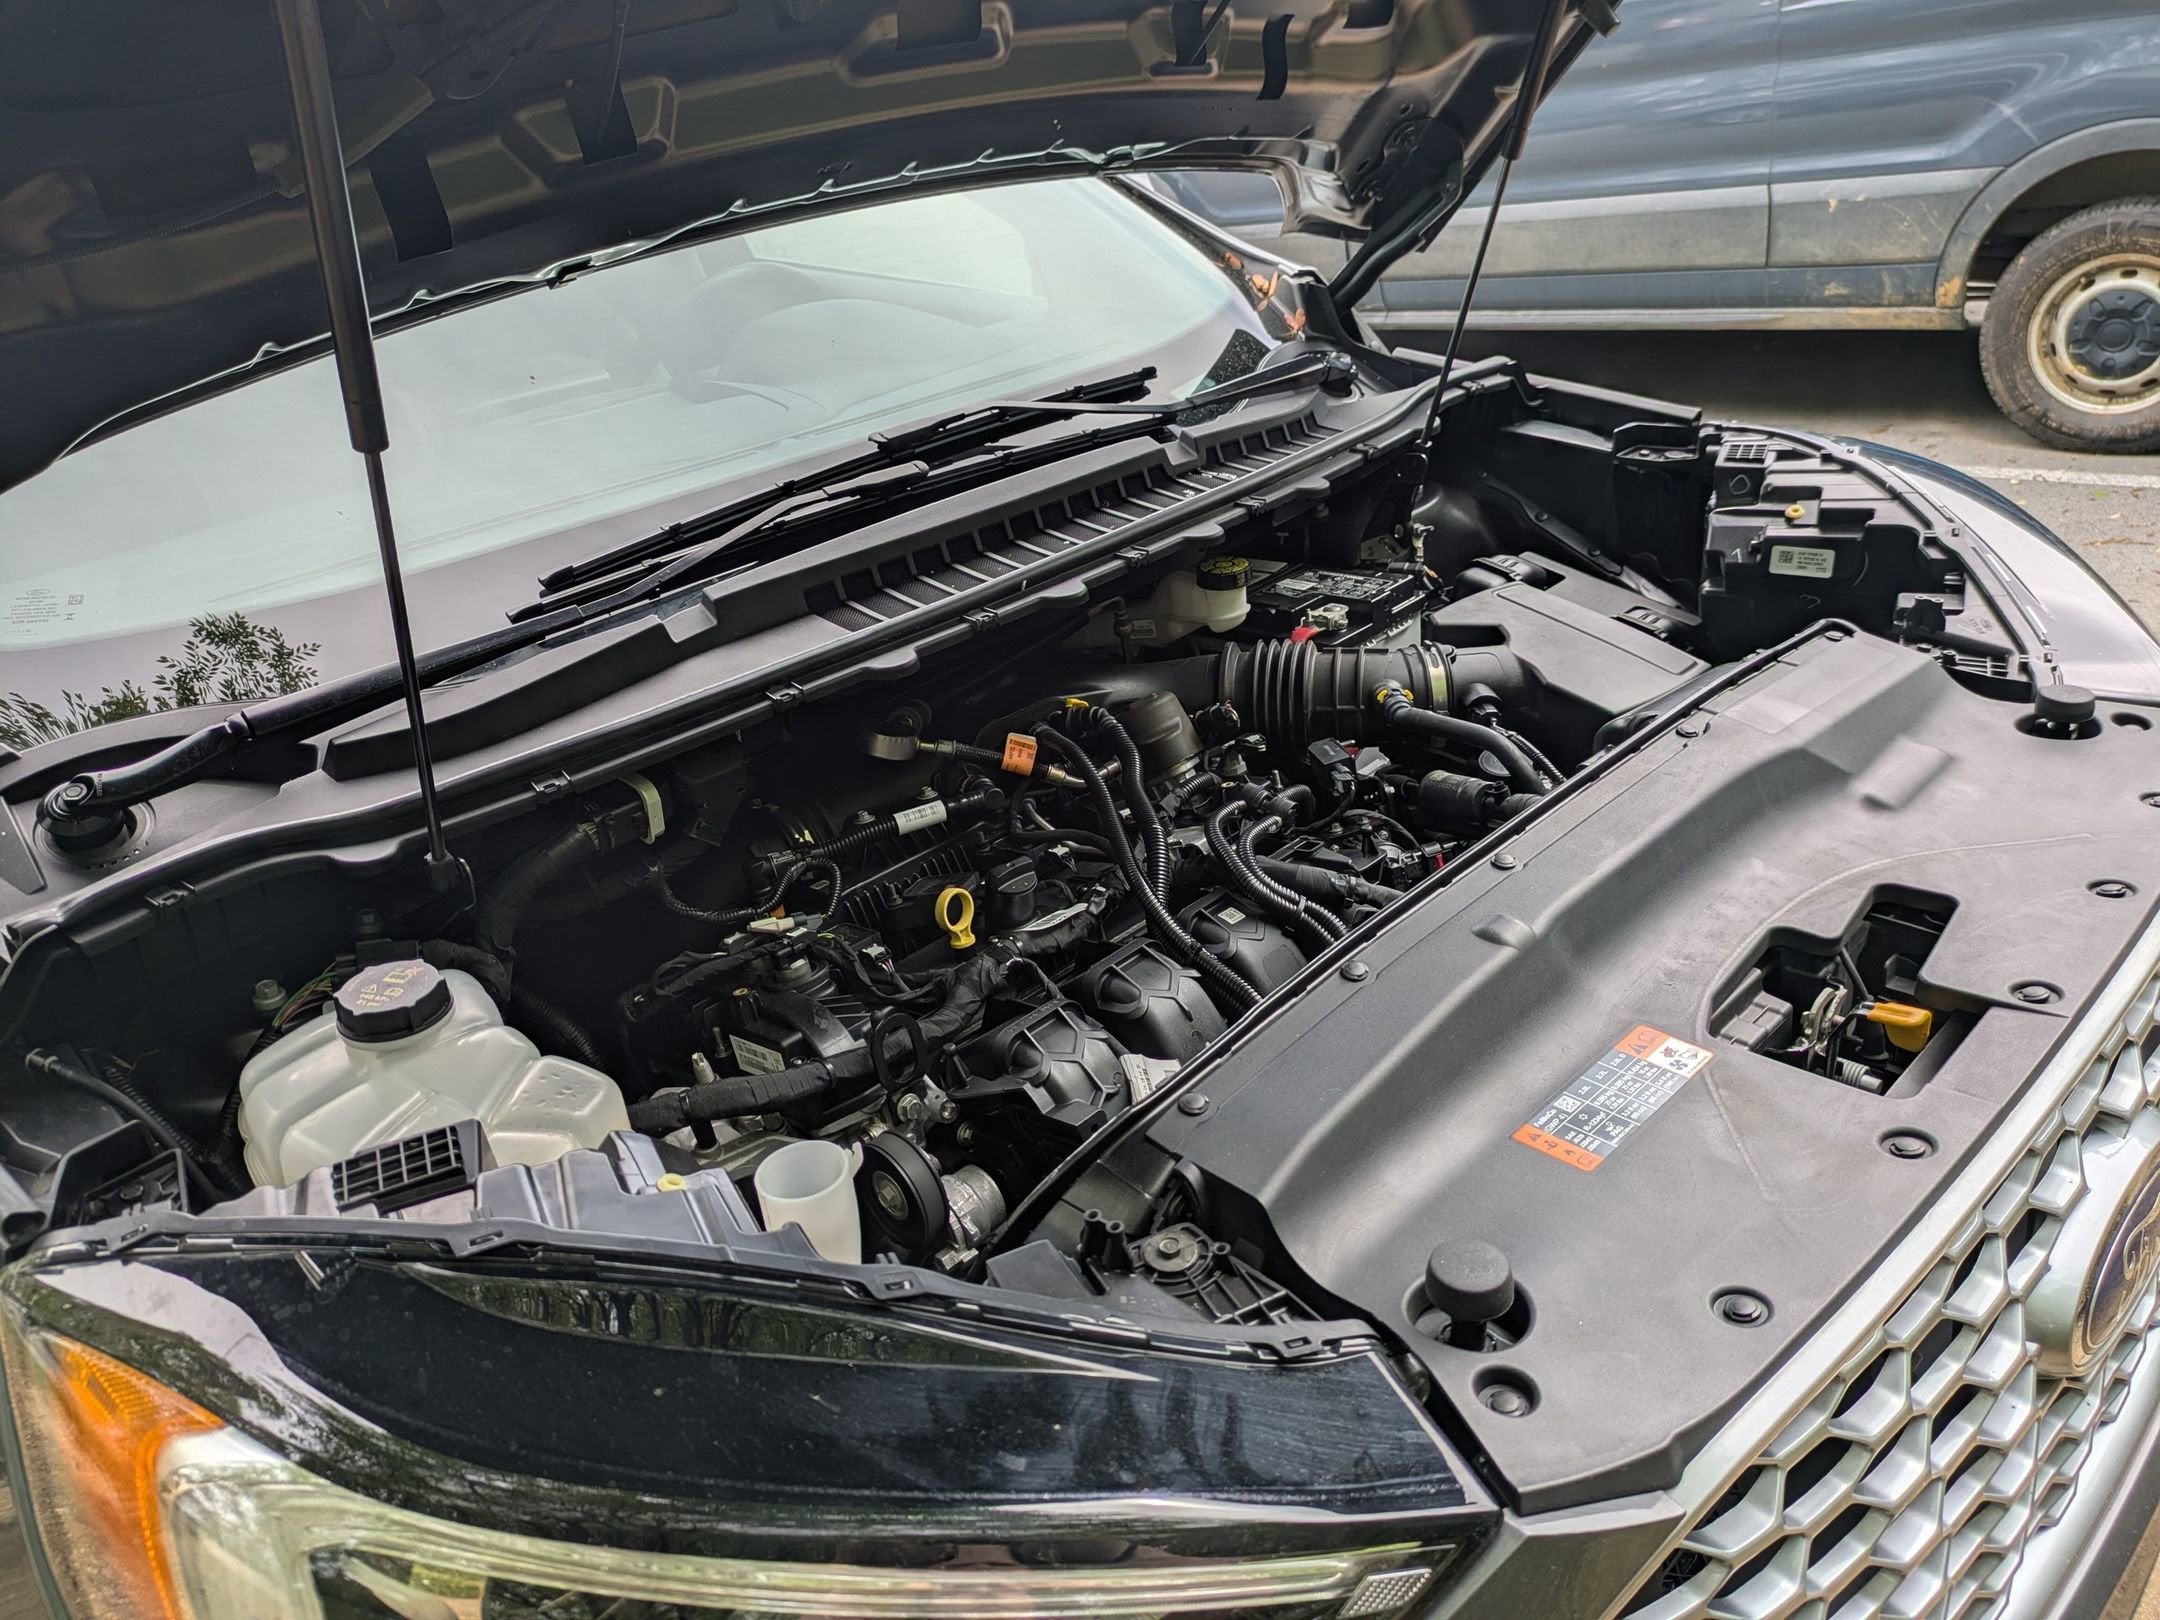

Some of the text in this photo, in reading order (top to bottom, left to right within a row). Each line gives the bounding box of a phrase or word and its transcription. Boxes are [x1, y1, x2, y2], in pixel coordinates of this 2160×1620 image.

[1595, 1070, 1608, 1079] 2.7L
[1533, 1109, 1556, 1127] FoMoCo
[1583, 1111, 1606, 1130] R-1234yf
[1609, 1125, 1623, 1136] PAG
